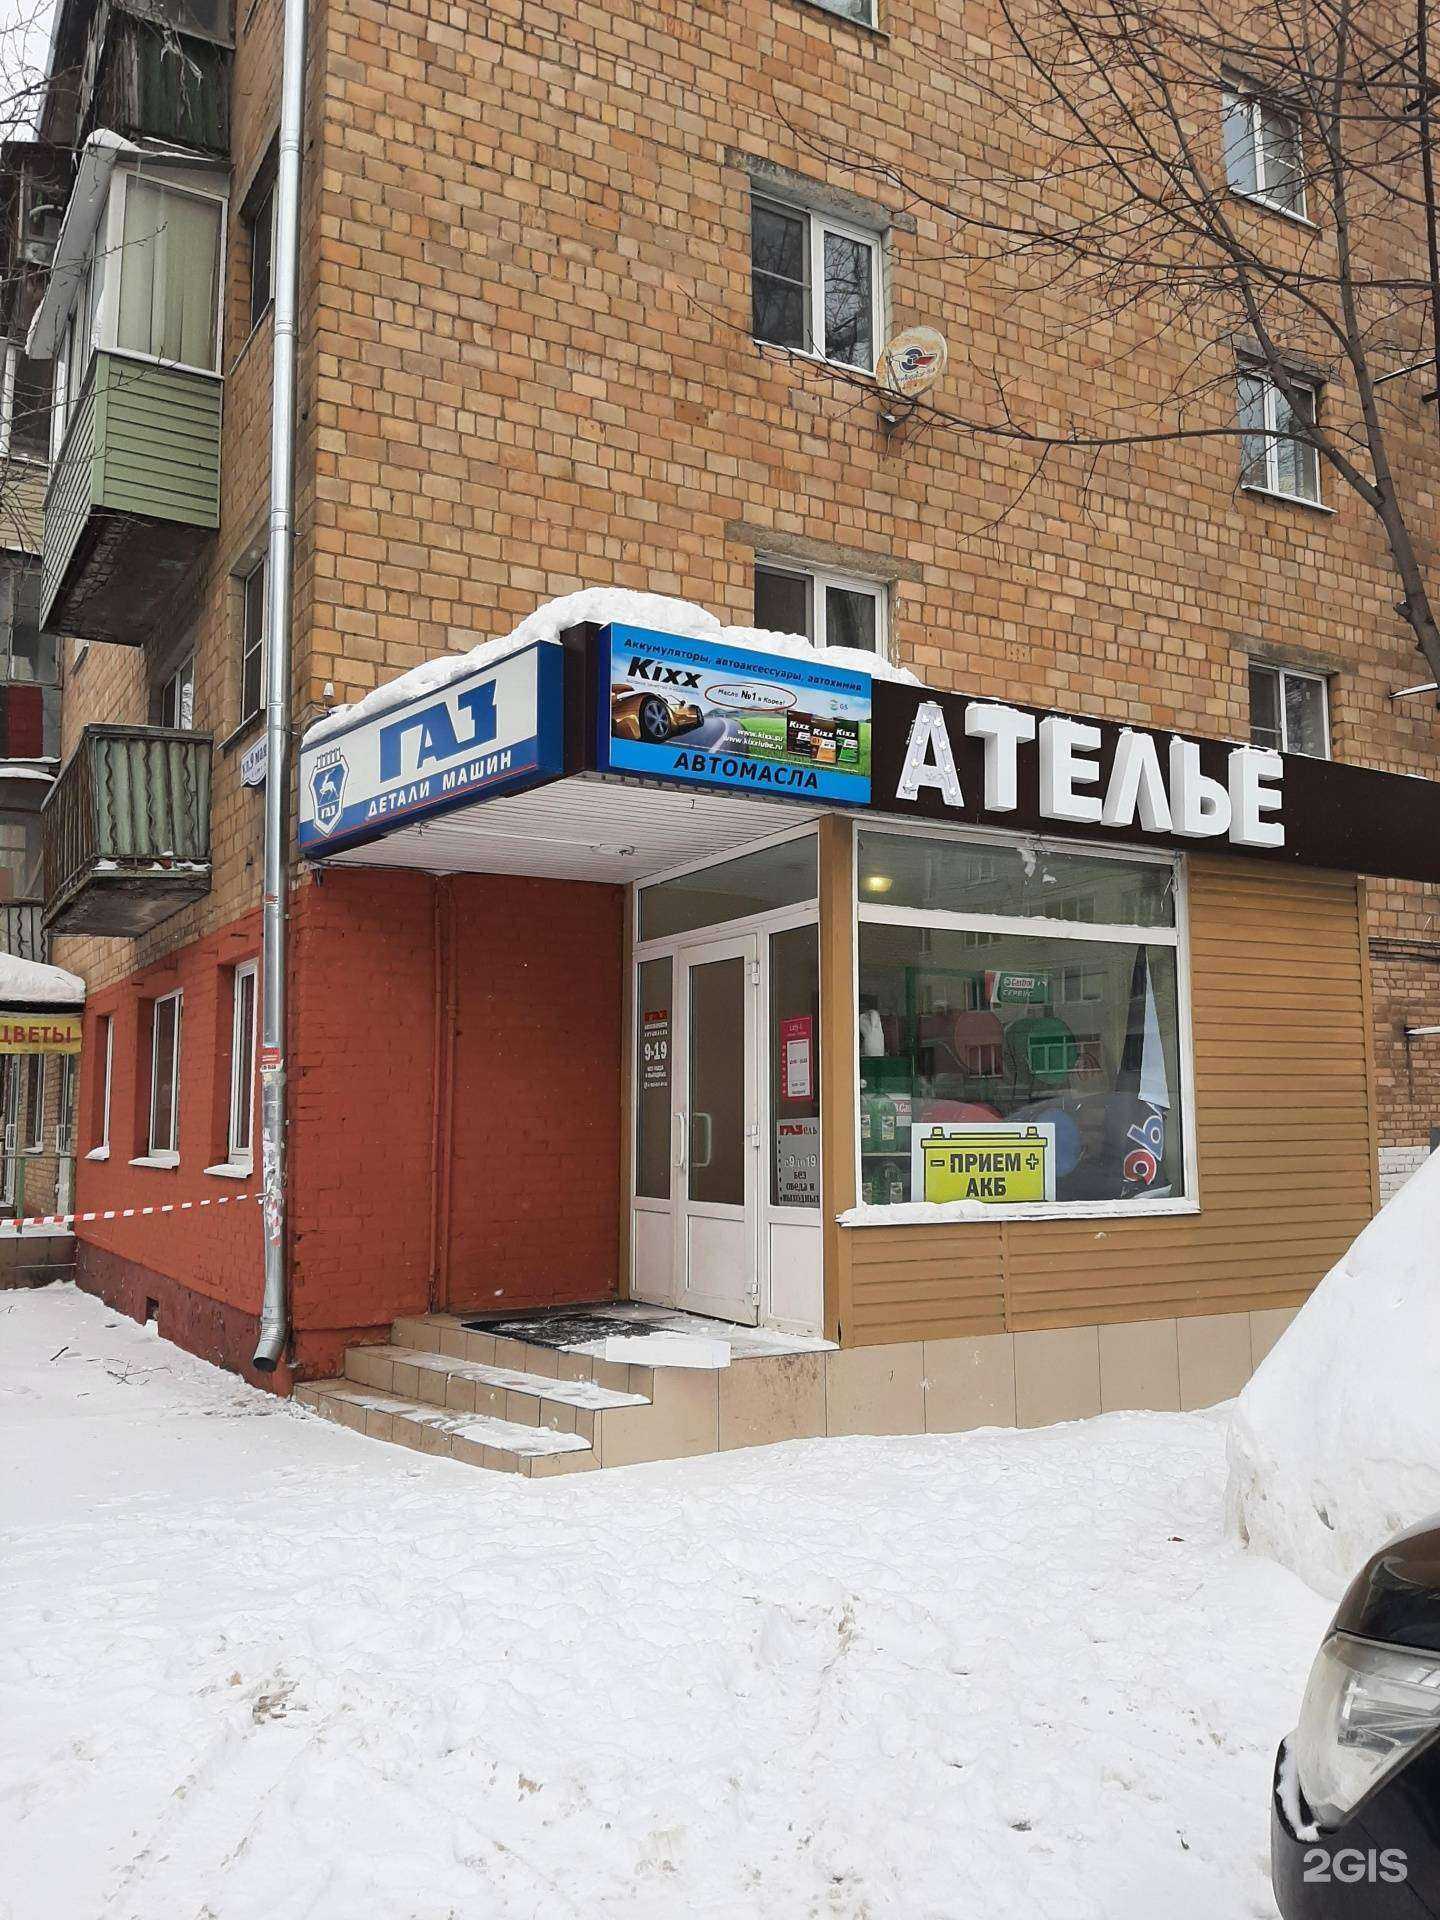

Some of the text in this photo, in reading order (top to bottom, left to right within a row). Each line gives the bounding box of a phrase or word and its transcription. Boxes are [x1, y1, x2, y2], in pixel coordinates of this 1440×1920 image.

[624, 638, 862, 692] Аккумуляторы, автоаксессуары, автохимия
[627, 656, 703, 688] Kixx
[380, 679, 497, 784] ГАЗ
[368, 750, 511, 817] ДЕТАЛИ МАШИН
[673, 751, 819, 789] АВТОМАСЛА
[896, 701, 1285, 848] АТЕЛЬЕ
[950, 1153, 1021, 1173] ПРИЕМ
[966, 1177, 1007, 1198] АКБ
